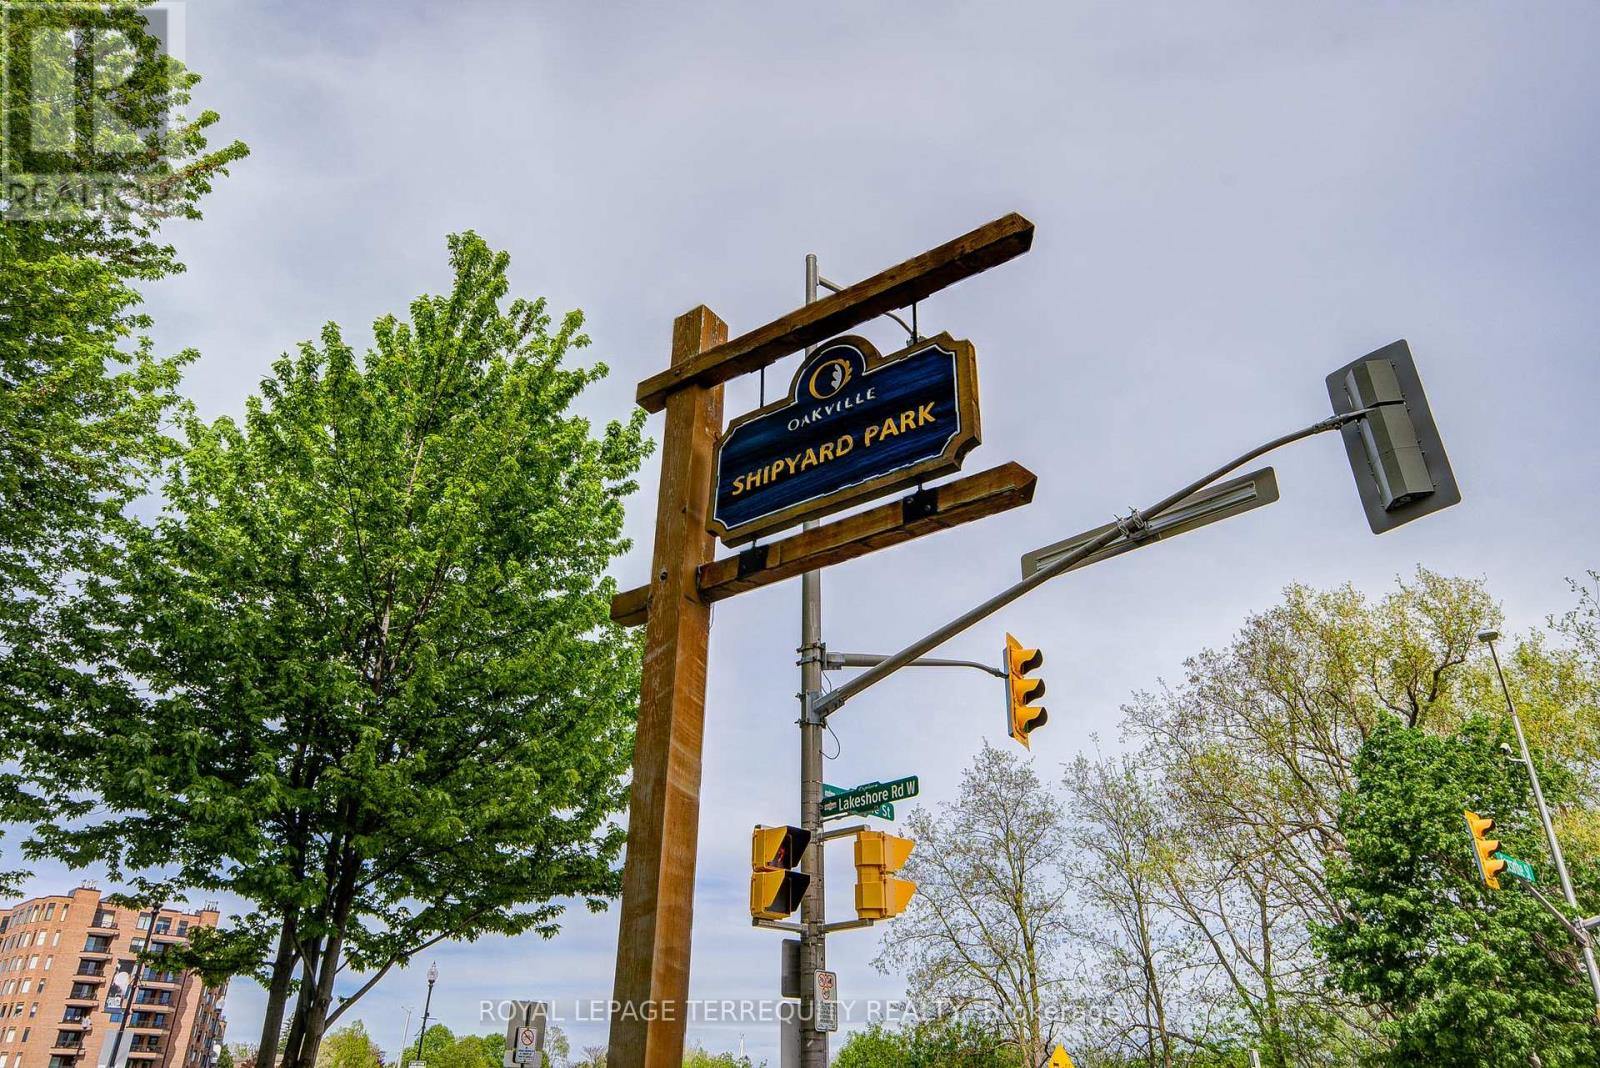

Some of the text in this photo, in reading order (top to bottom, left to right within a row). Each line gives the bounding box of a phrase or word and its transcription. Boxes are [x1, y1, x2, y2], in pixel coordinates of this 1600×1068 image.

[788, 387, 876, 431] OAKVILLE
[731, 402, 936, 496] SHIPYARD PARK
[838, 790, 888, 812] Lakeshore
[891, 783, 904, 799] Rd
[906, 780, 915, 795] W
[881, 805, 891, 818] St
